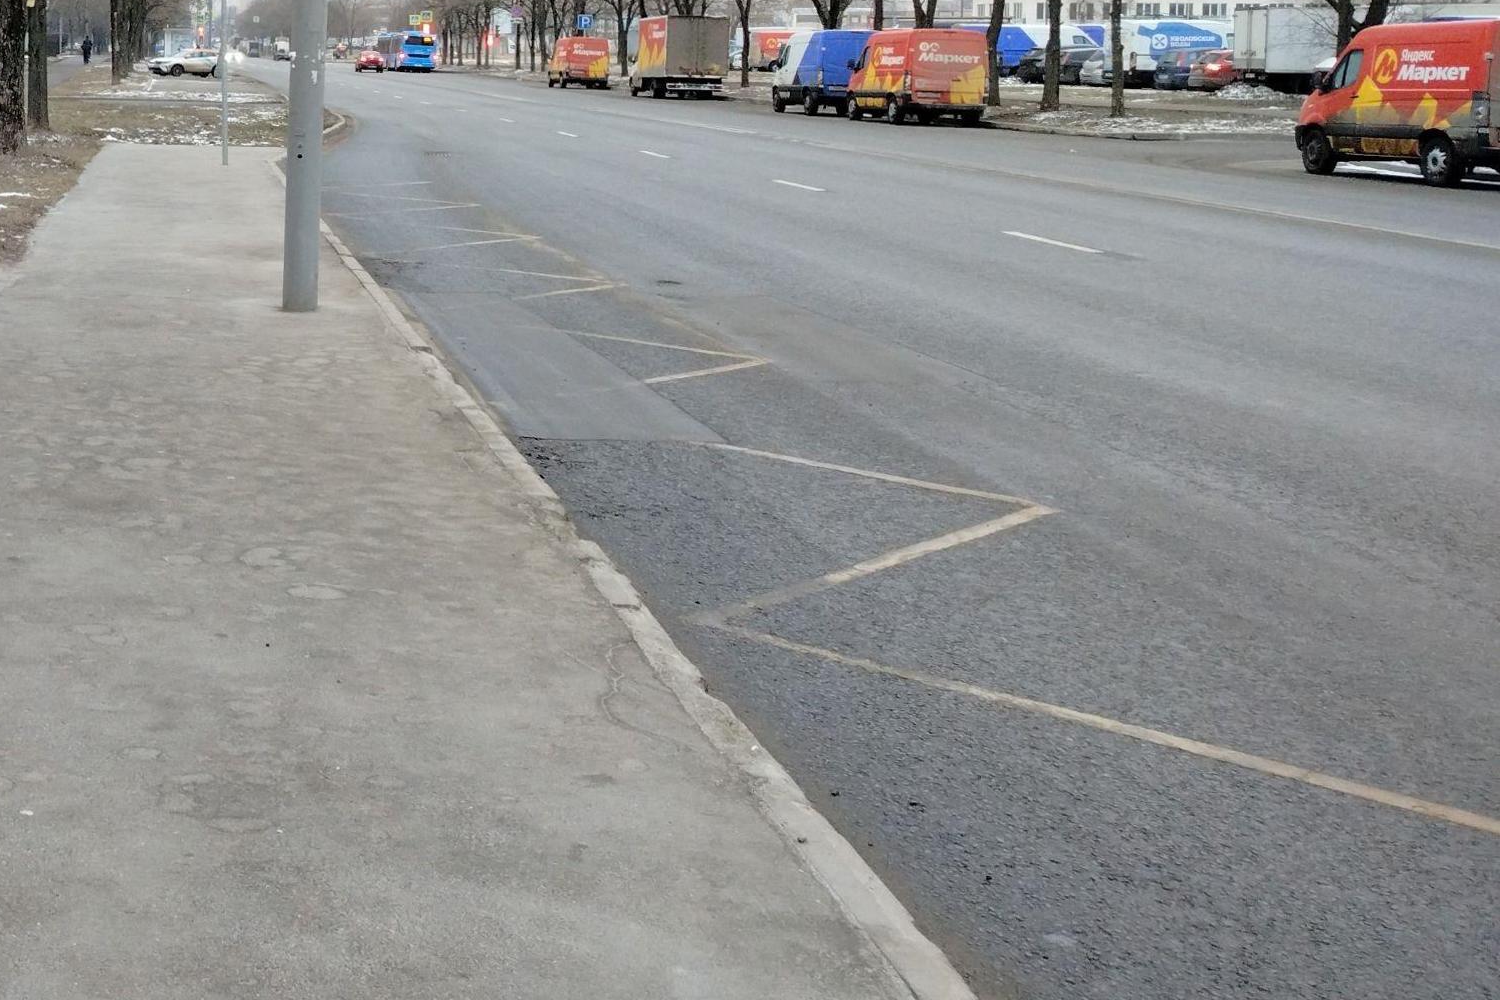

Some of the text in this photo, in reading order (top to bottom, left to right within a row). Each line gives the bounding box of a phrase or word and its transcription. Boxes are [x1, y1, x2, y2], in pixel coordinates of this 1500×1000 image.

[918, 52, 981, 65] Маркет
[1400, 49, 1436, 63] Яндекс
[1396, 64, 1470, 84] Маркет
